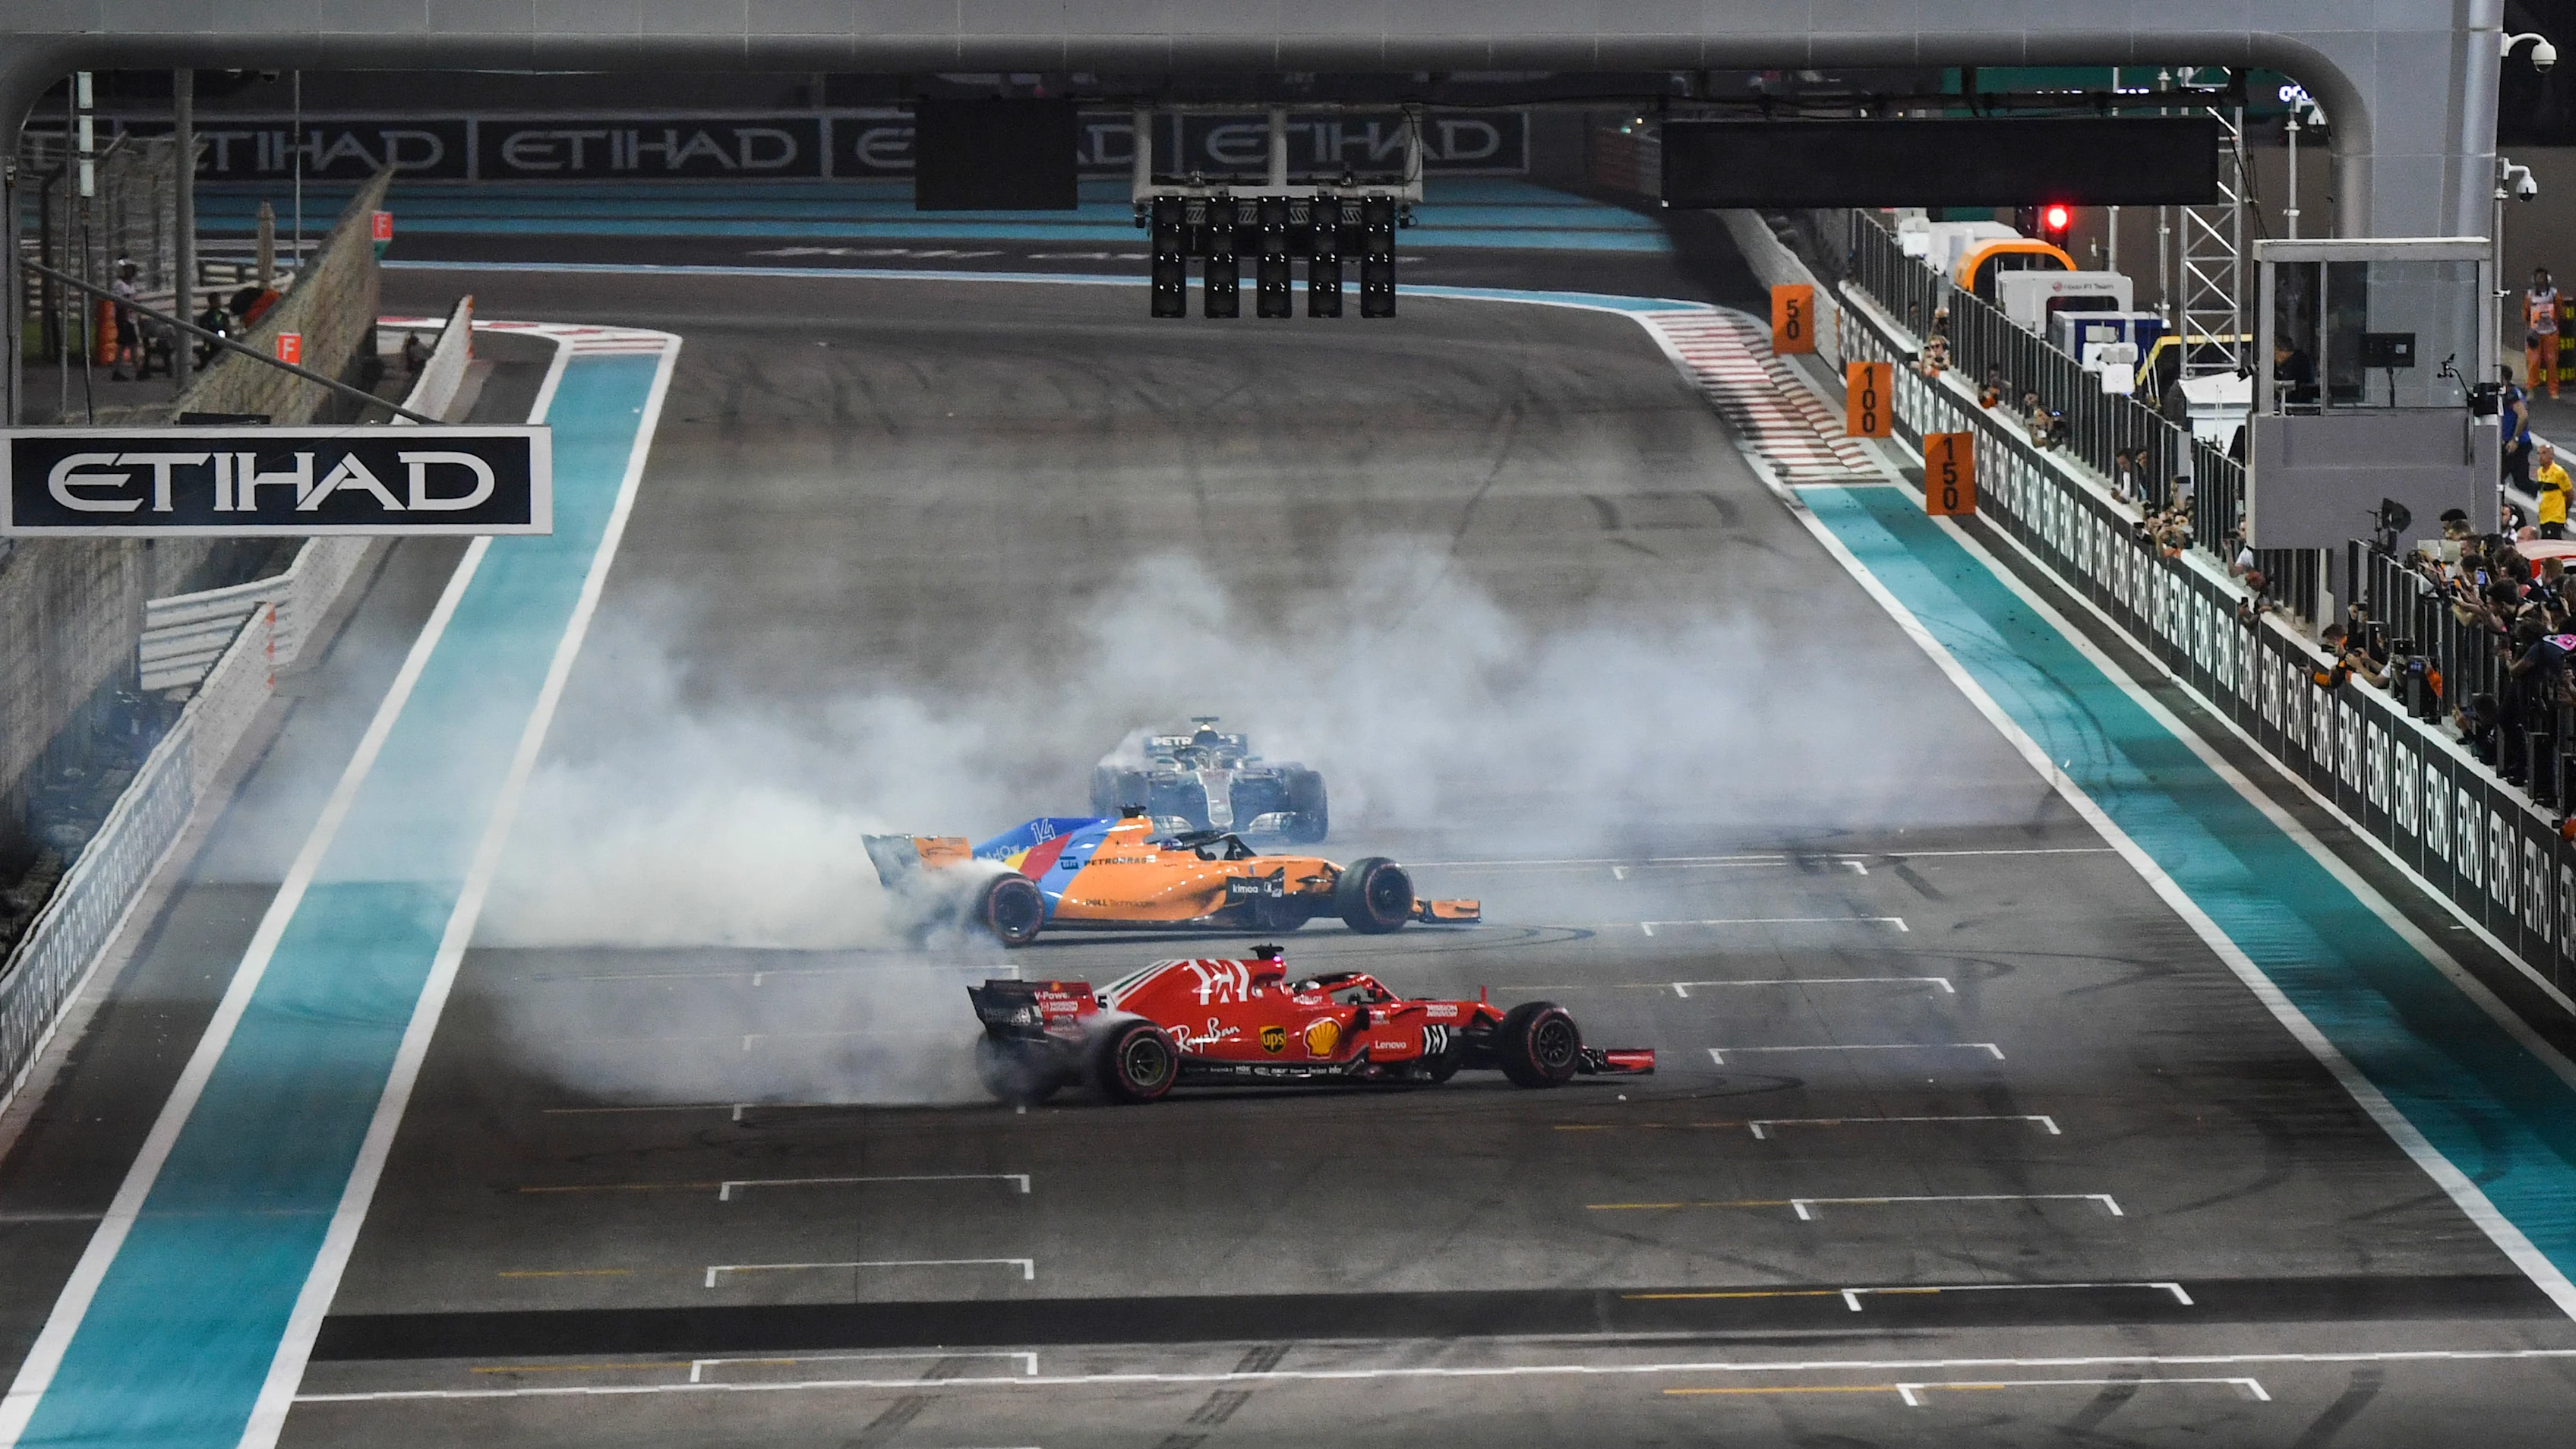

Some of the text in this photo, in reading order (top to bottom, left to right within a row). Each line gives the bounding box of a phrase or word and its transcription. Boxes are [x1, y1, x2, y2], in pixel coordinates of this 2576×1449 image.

[195, 130, 444, 172] TIHAD
[501, 129, 798, 170] ETIHAD
[377, 216, 387, 235] F
[1786, 298, 1800, 339] 50
[282, 338, 296, 358] F
[1862, 365, 1877, 434] 100
[48, 451, 495, 513] ETIHAD
[1942, 437, 1959, 511] 150
[1031, 818, 1057, 845] 14
[1233, 883, 1259, 894] kimoa
[1097, 995, 1107, 1009] 5
[1166, 1017, 1241, 1054] Ray-Ban
[1262, 1034, 1285, 1051] ups
[1375, 1040, 1407, 1050] Lenovo
